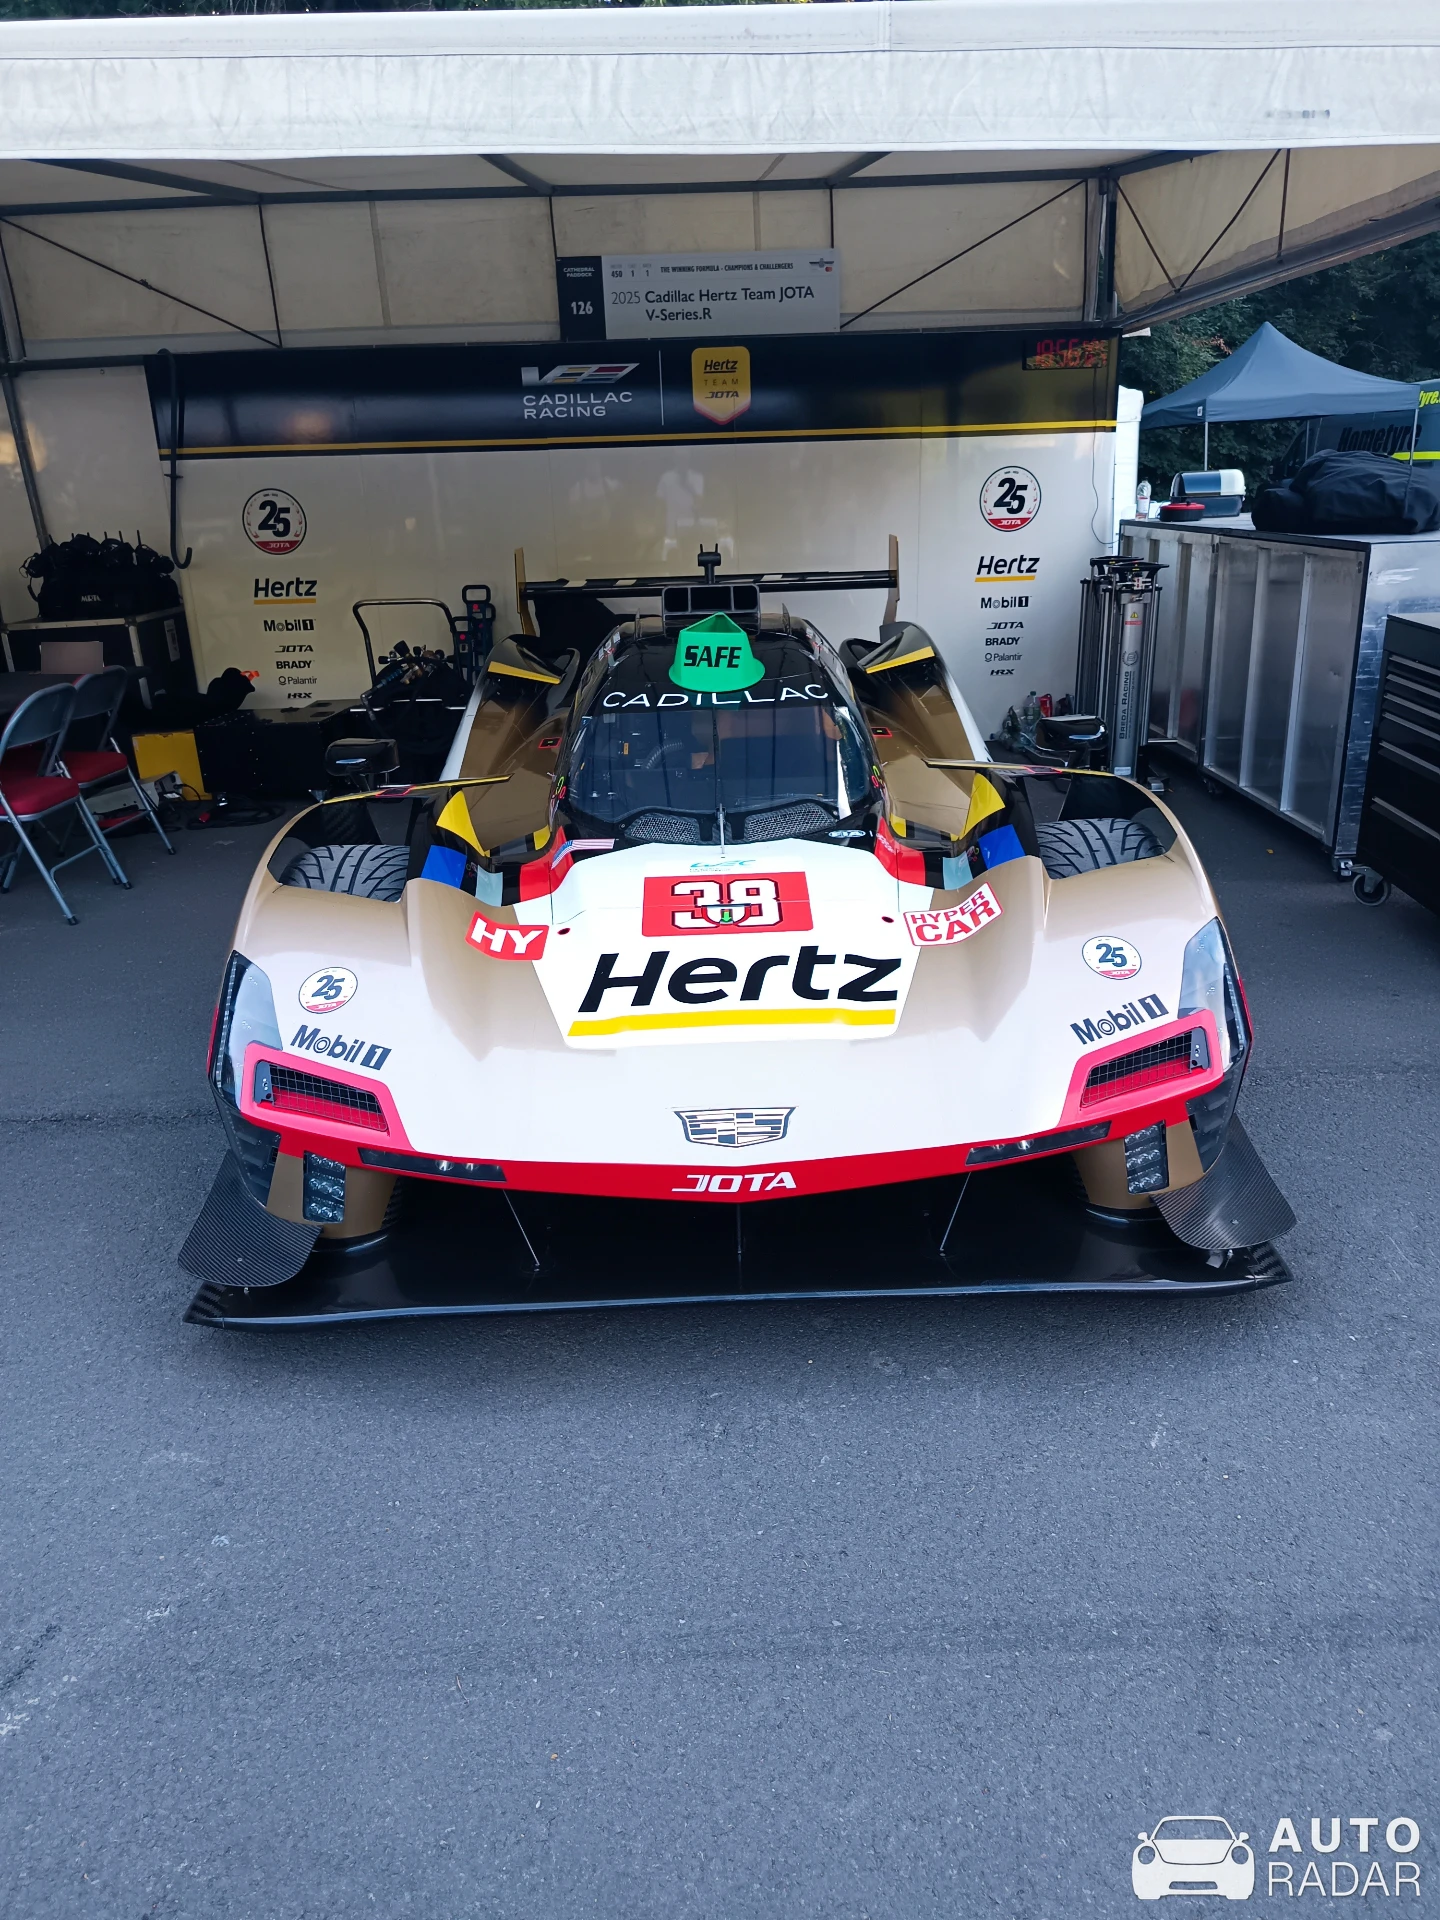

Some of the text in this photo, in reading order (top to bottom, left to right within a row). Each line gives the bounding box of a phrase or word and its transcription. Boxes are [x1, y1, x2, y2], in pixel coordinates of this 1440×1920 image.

[611, 270, 623, 278] 450
[671, 265, 695, 273] WINNING
[724, 264, 753, 272] CHAMPIONS
[759, 262, 793, 270] CHALLENGERS
[611, 286, 815, 305] 2025 Cadillac Hertz Team JOTA
[571, 301, 593, 315] 126
[645, 307, 712, 321] V-Series.R
[703, 359, 738, 371] Hertz
[704, 378, 739, 386] TEAM
[522, 391, 633, 406] CADILLAC
[704, 390, 740, 399] JOTA
[523, 405, 607, 420] RACING
[1337, 423, 1422, 456] Hometyre
[993, 477, 1028, 514] 25
[258, 500, 290, 537] 25
[976, 554, 1040, 576] Hertz
[253, 577, 317, 598] Hertz
[980, 596, 1017, 609] Mobil
[263, 619, 301, 631] Mobil
[986, 621, 1024, 630] JOTA
[274, 644, 314, 653] JOTA
[985, 637, 1020, 646] BRADY
[275, 660, 312, 669] BRADY
[683, 645, 742, 669] SAFE
[993, 652, 1022, 662] Palantir
[287, 675, 317, 685] Palantir
[989, 668, 1015, 676] HRX
[602, 684, 829, 708] CADILLAC
[1119, 671, 1130, 739] BREDA RACING
[671, 878, 784, 930] 38
[910, 890, 986, 925] HYPER
[915, 900, 996, 942] CAR
[470, 917, 543, 955] HY
[1095, 943, 1128, 968] 25
[311, 974, 345, 1000] 25
[578, 945, 902, 1013] Hertz
[1070, 1002, 1146, 1045] Mobil
[290, 1024, 366, 1063] Mobil
[671, 1171, 797, 1193] JOTA
